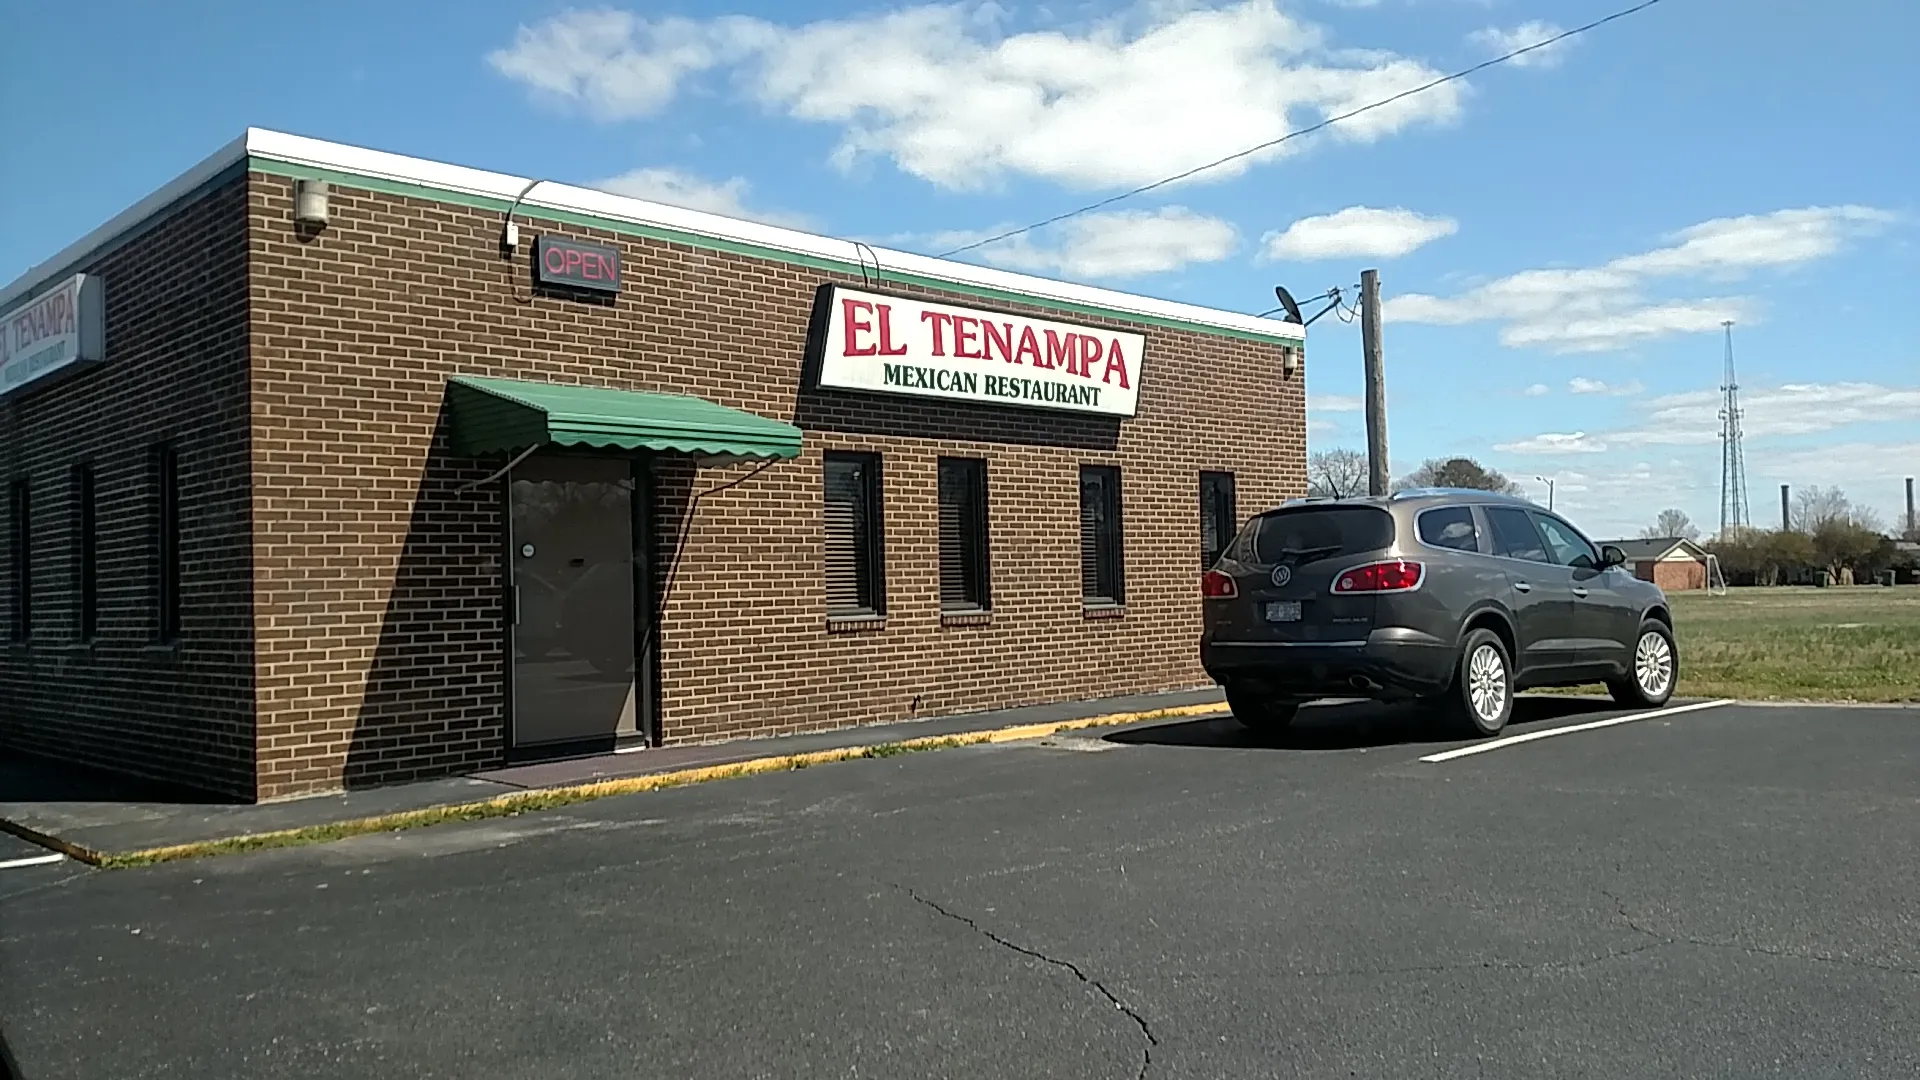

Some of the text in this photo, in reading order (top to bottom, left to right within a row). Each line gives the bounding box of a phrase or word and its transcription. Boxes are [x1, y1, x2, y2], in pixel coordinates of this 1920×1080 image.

[544, 247, 616, 281] OPEN
[12, 288, 76, 354] TENAMPA
[841, 298, 1130, 390] EL TENAMPA
[883, 363, 1102, 407] MEXICAN RESTAURANT
